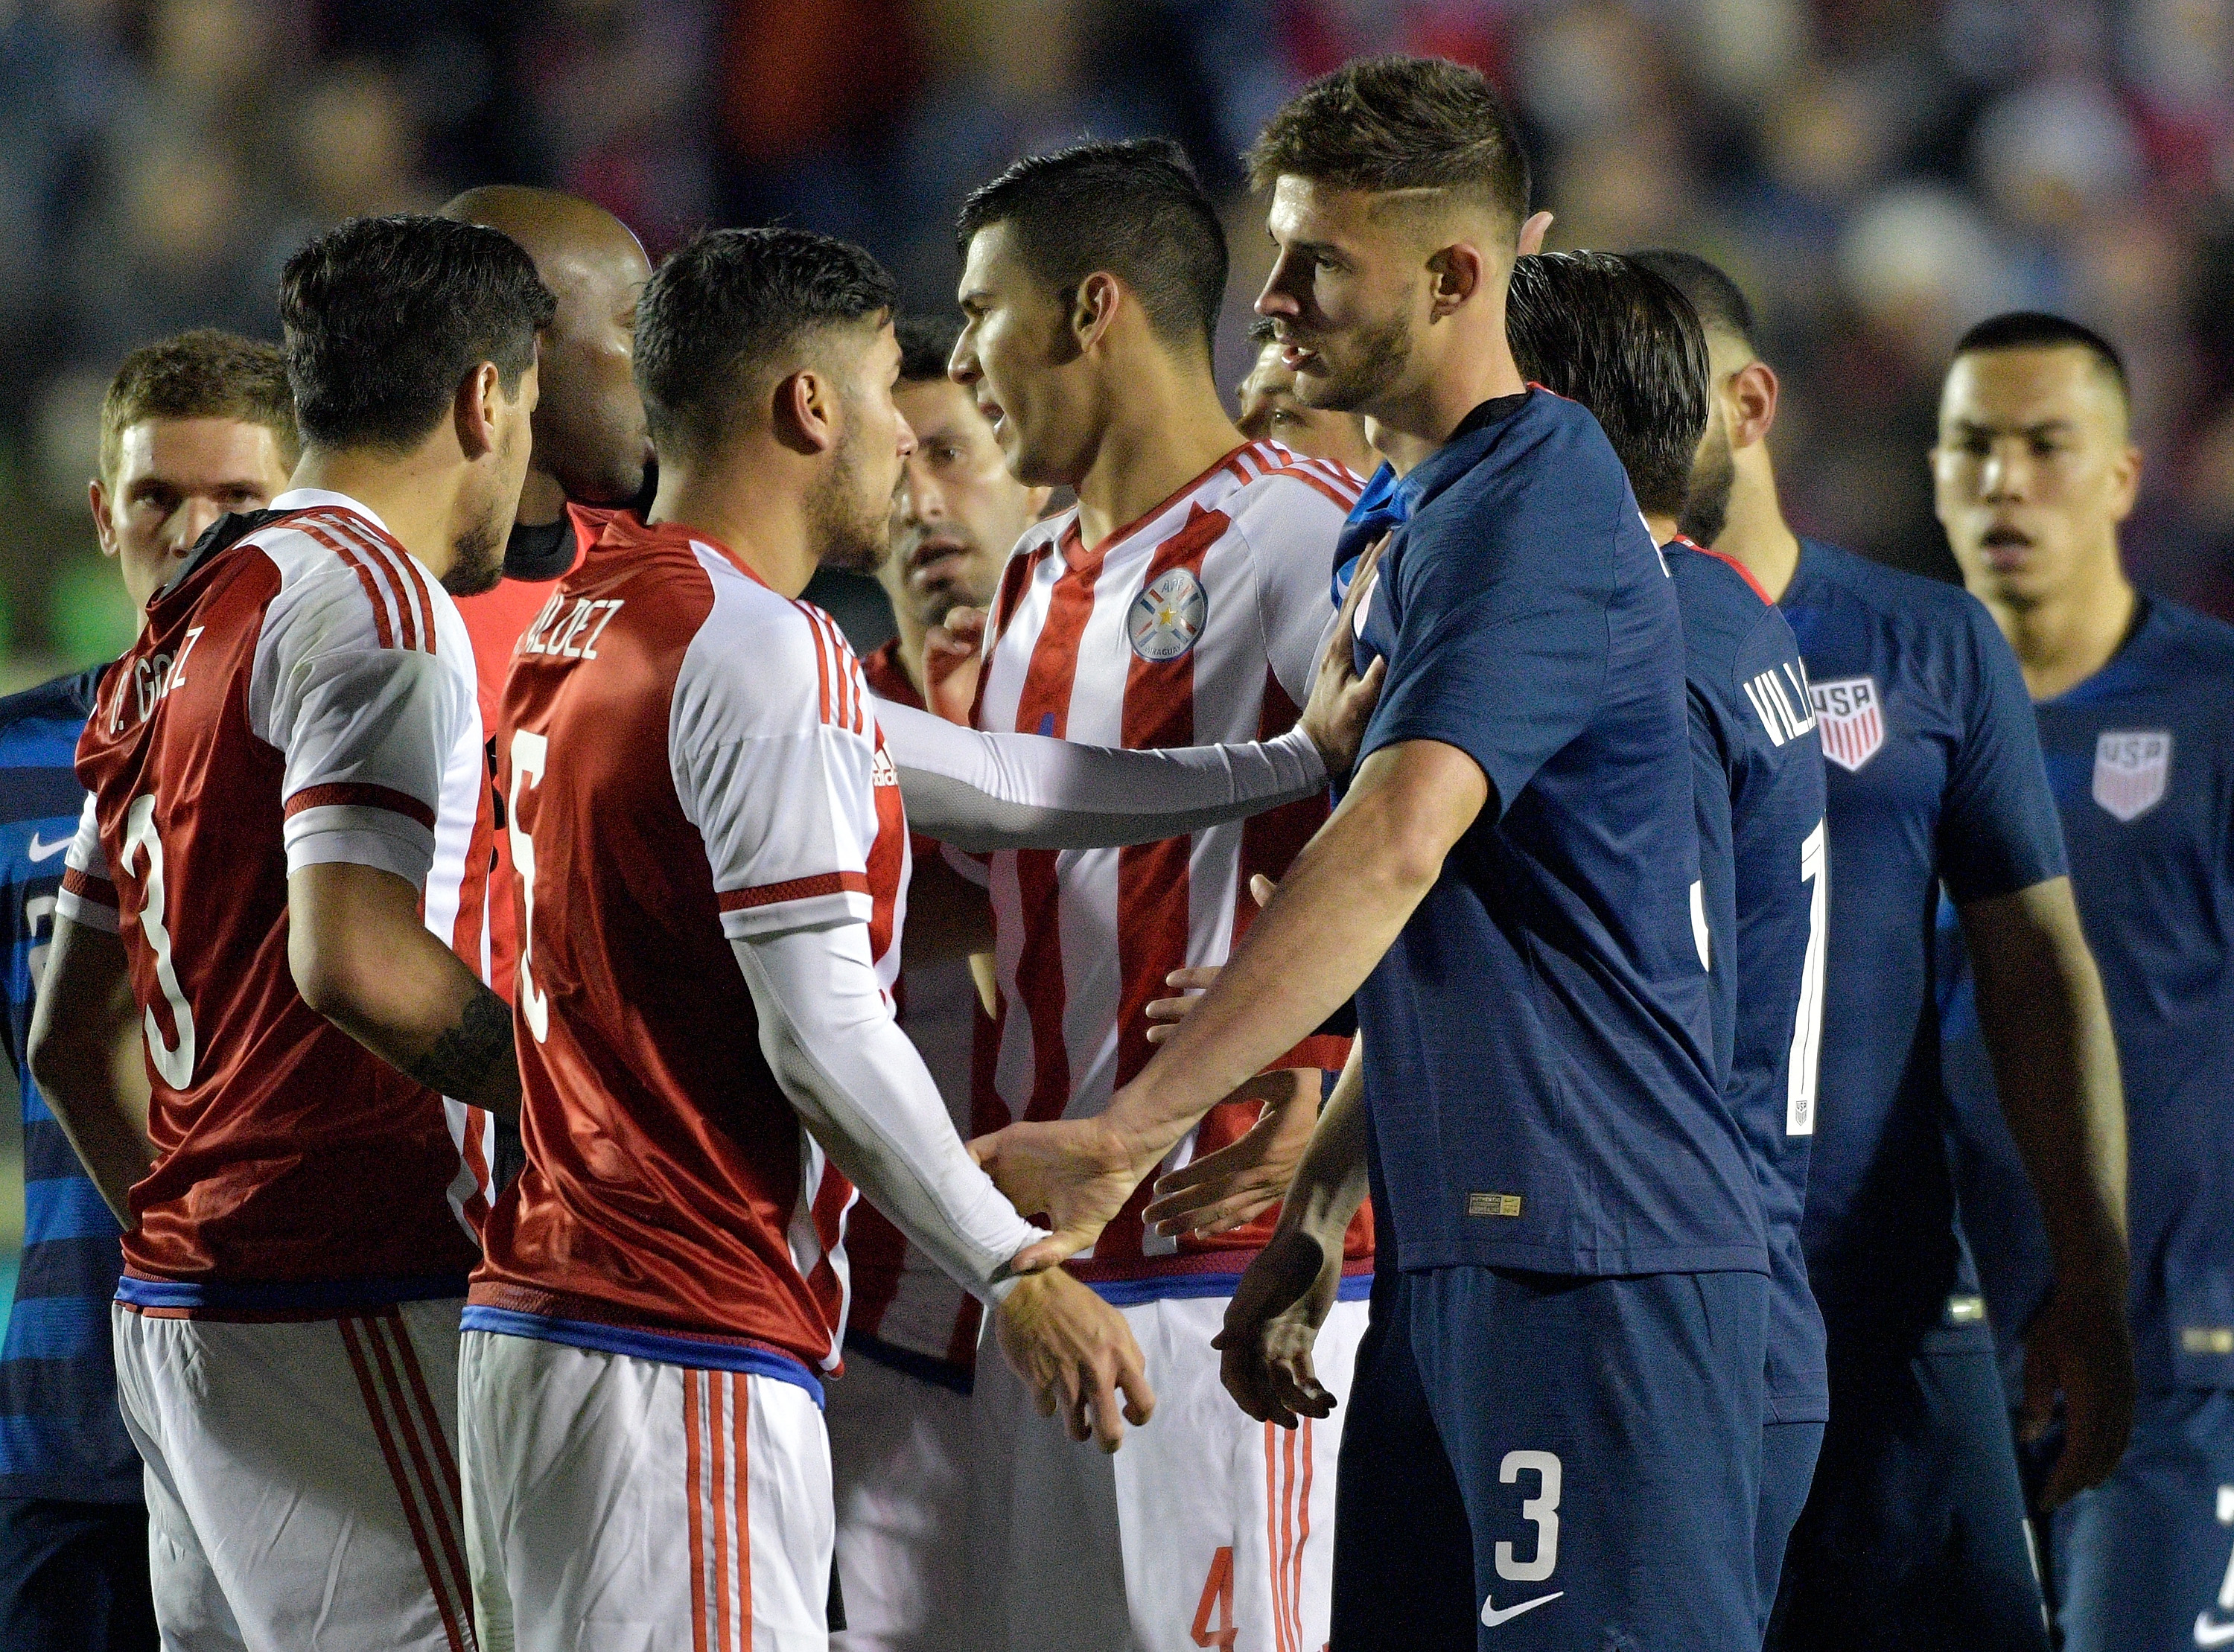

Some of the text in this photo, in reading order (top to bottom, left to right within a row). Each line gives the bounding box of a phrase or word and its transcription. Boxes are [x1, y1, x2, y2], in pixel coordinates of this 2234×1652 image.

[1811, 684, 1871, 717] USA
[2101, 741, 2161, 769] USA
[121, 794, 195, 1090] 3
[1495, 1450, 1562, 1581] 3
[1191, 1546, 1239, 1652] 4
